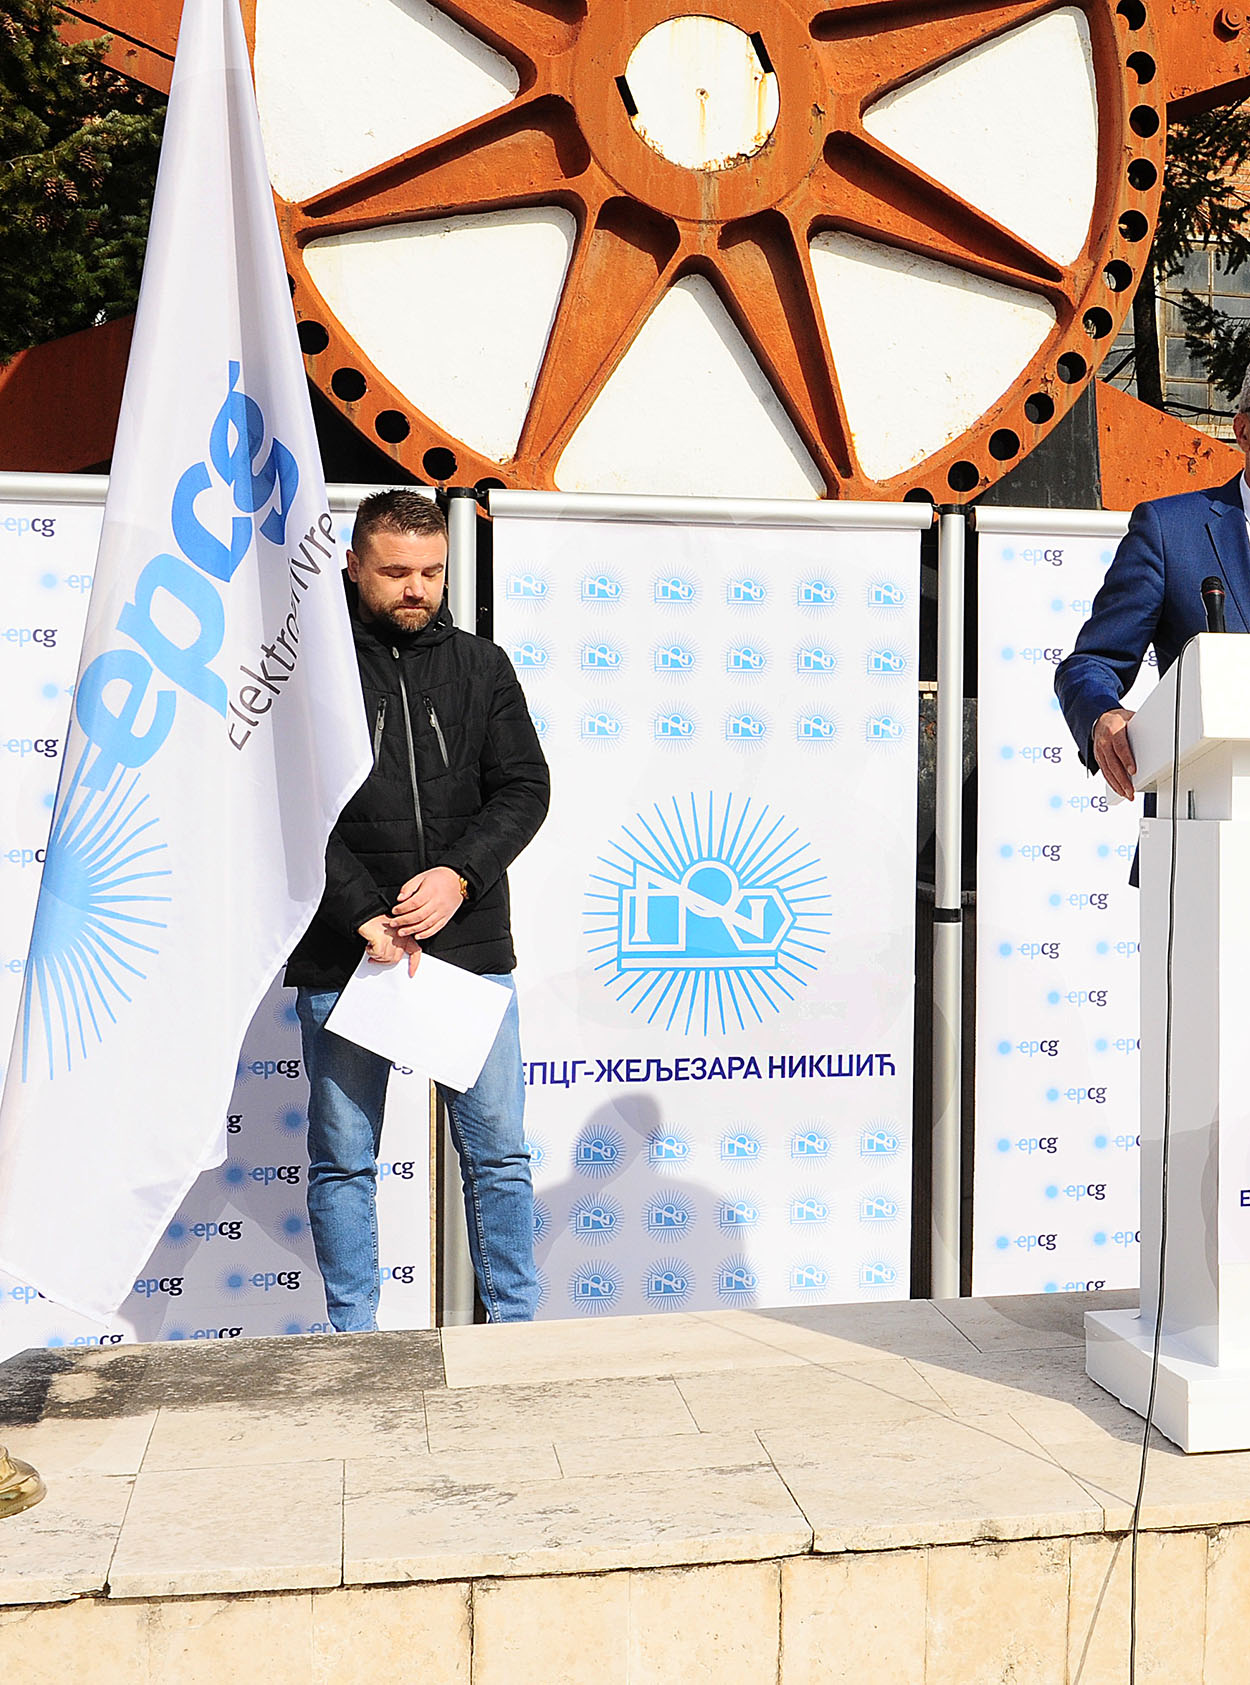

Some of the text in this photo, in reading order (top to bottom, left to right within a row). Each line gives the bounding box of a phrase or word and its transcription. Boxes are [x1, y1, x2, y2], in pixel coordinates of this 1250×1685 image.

[68, 573, 93, 590] ep
[8, 849, 46, 868] epc
[768, 1053, 896, 1078] НИКШИЋ
[380, 1161, 414, 1180] pcg
[380, 1265, 414, 1284] pcg
